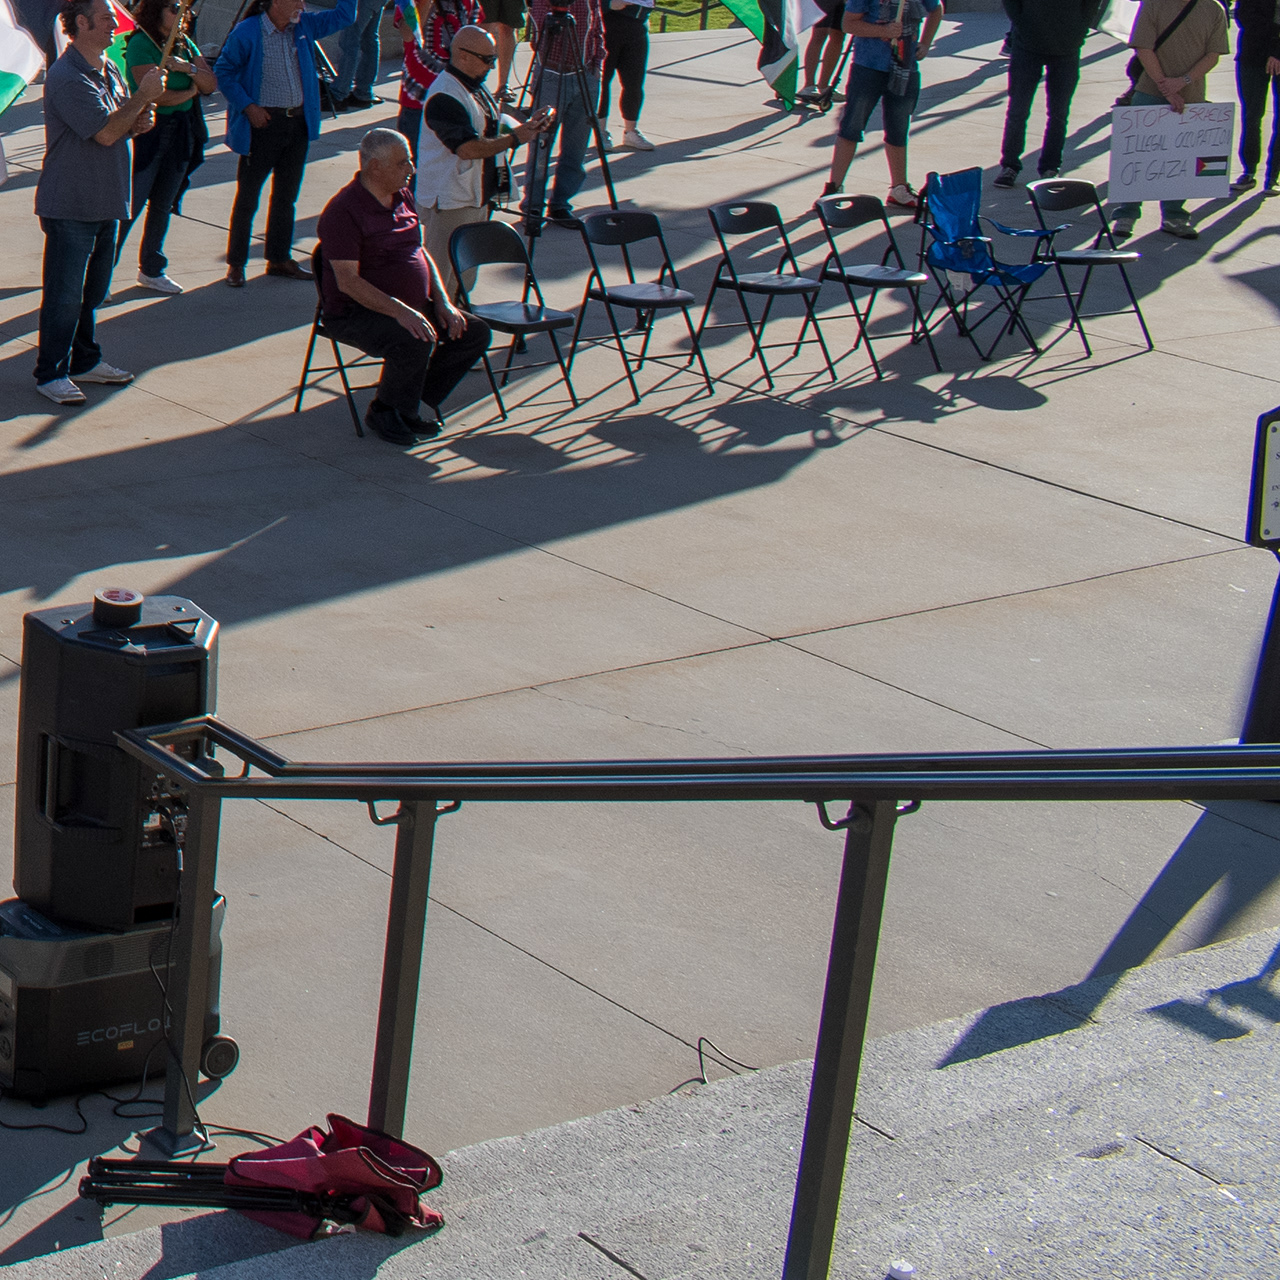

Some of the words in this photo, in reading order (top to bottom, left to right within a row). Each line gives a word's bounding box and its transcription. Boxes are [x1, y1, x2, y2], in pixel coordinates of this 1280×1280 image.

[1121, 107, 1171, 134] STOP
[1121, 162, 1142, 186] OF
[1145, 160, 1187, 181] GAZA
